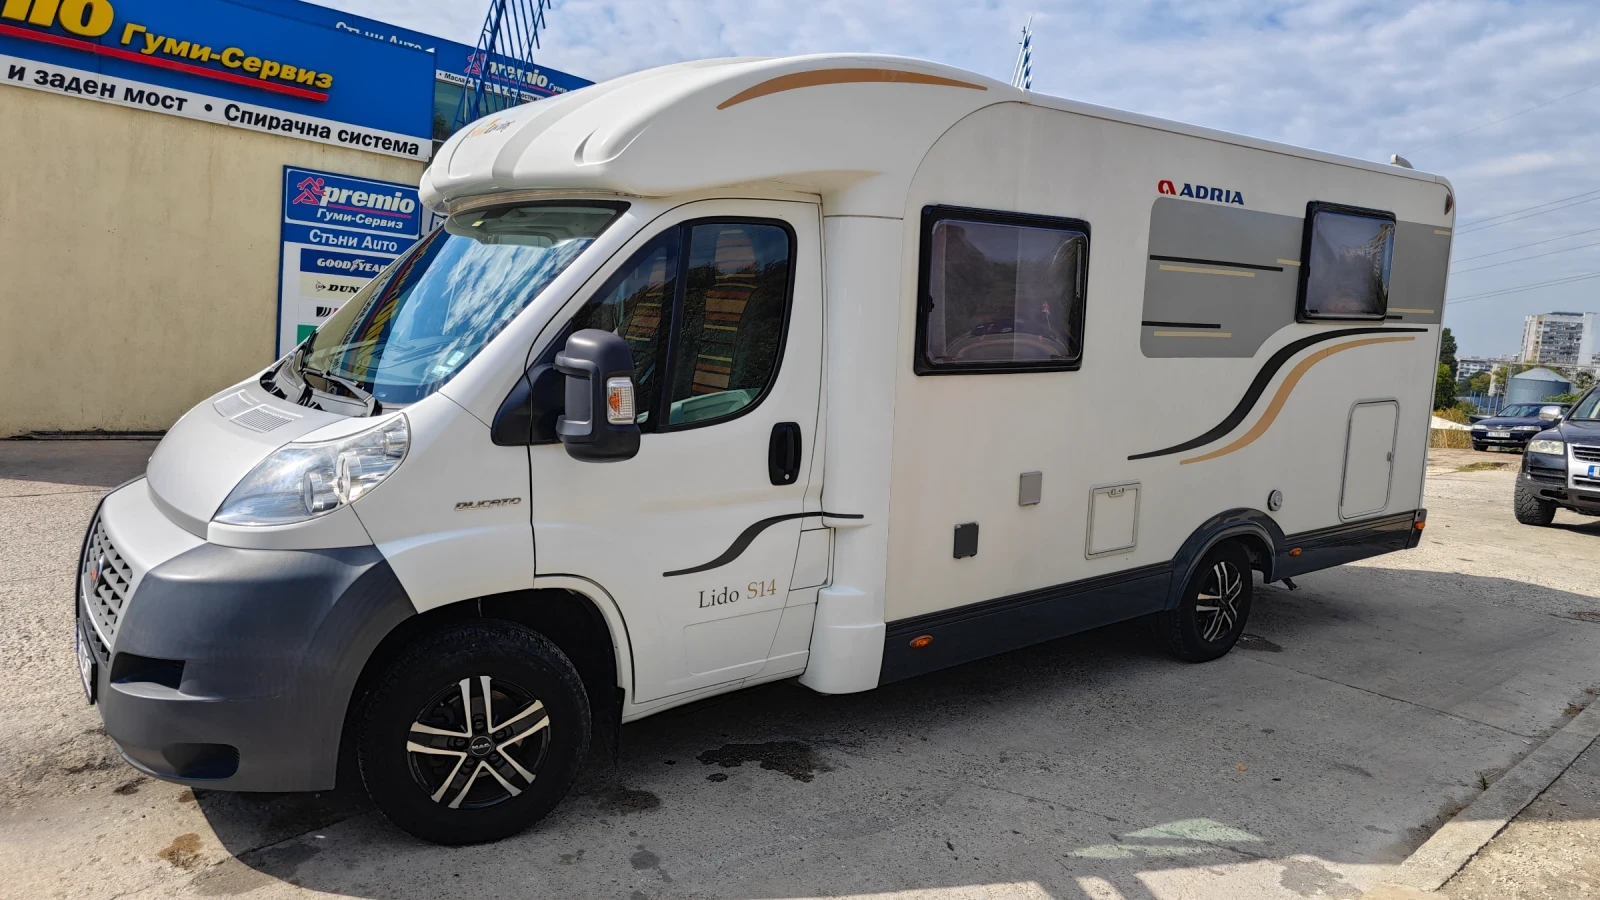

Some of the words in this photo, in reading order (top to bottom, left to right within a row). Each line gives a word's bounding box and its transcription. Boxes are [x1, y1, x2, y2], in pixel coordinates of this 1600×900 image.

[120, 23, 333, 89] Гуми-Сервиз
[8, 65, 26, 81] и
[34, 70, 116, 98] заден
[124, 84, 187, 111] мост
[224, 104, 331, 139] Спирачна
[337, 129, 419, 155] система
[320, 186, 415, 214] premio
[1179, 183, 1244, 205] ADRIA
[317, 208, 403, 228] Гуми-Сервиз
[309, 229, 357, 248] Стъни
[454, 497, 521, 511] DUCATO
[699, 587, 739, 608] Lido
[747, 579, 777, 599] S14
